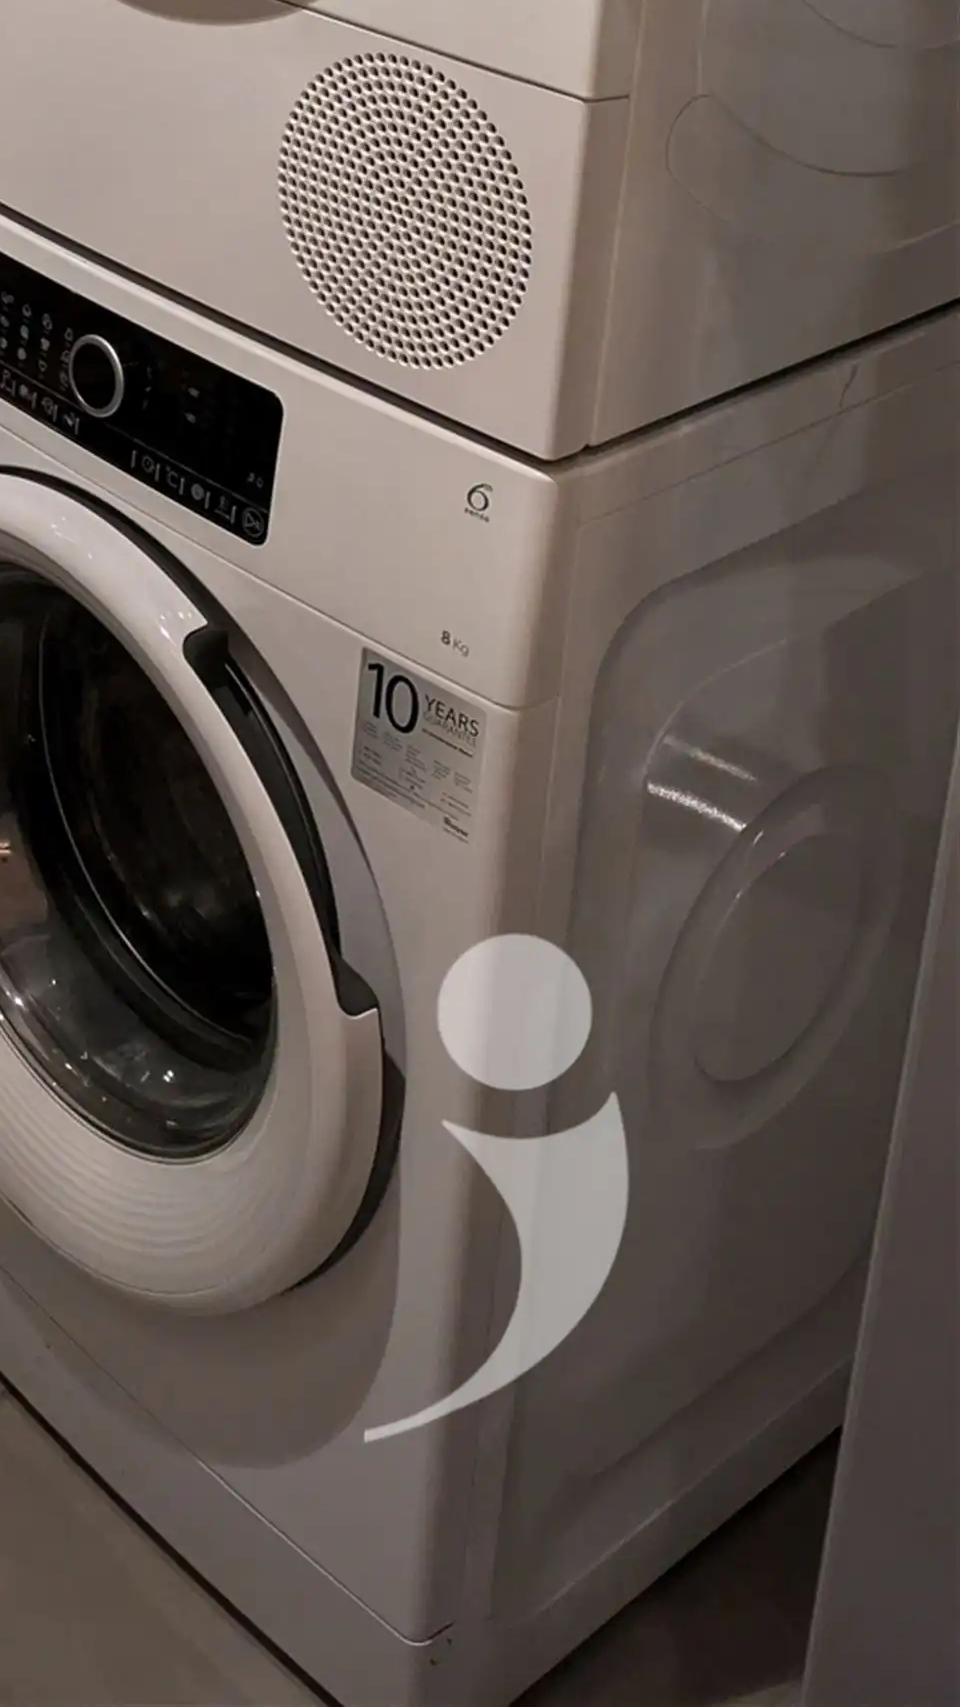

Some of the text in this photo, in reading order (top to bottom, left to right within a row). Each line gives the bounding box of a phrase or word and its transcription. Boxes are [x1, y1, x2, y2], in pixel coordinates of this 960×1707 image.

[440, 630, 451, 645] 8
[366, 661, 420, 735] 10
[424, 694, 480, 738] YEARS
